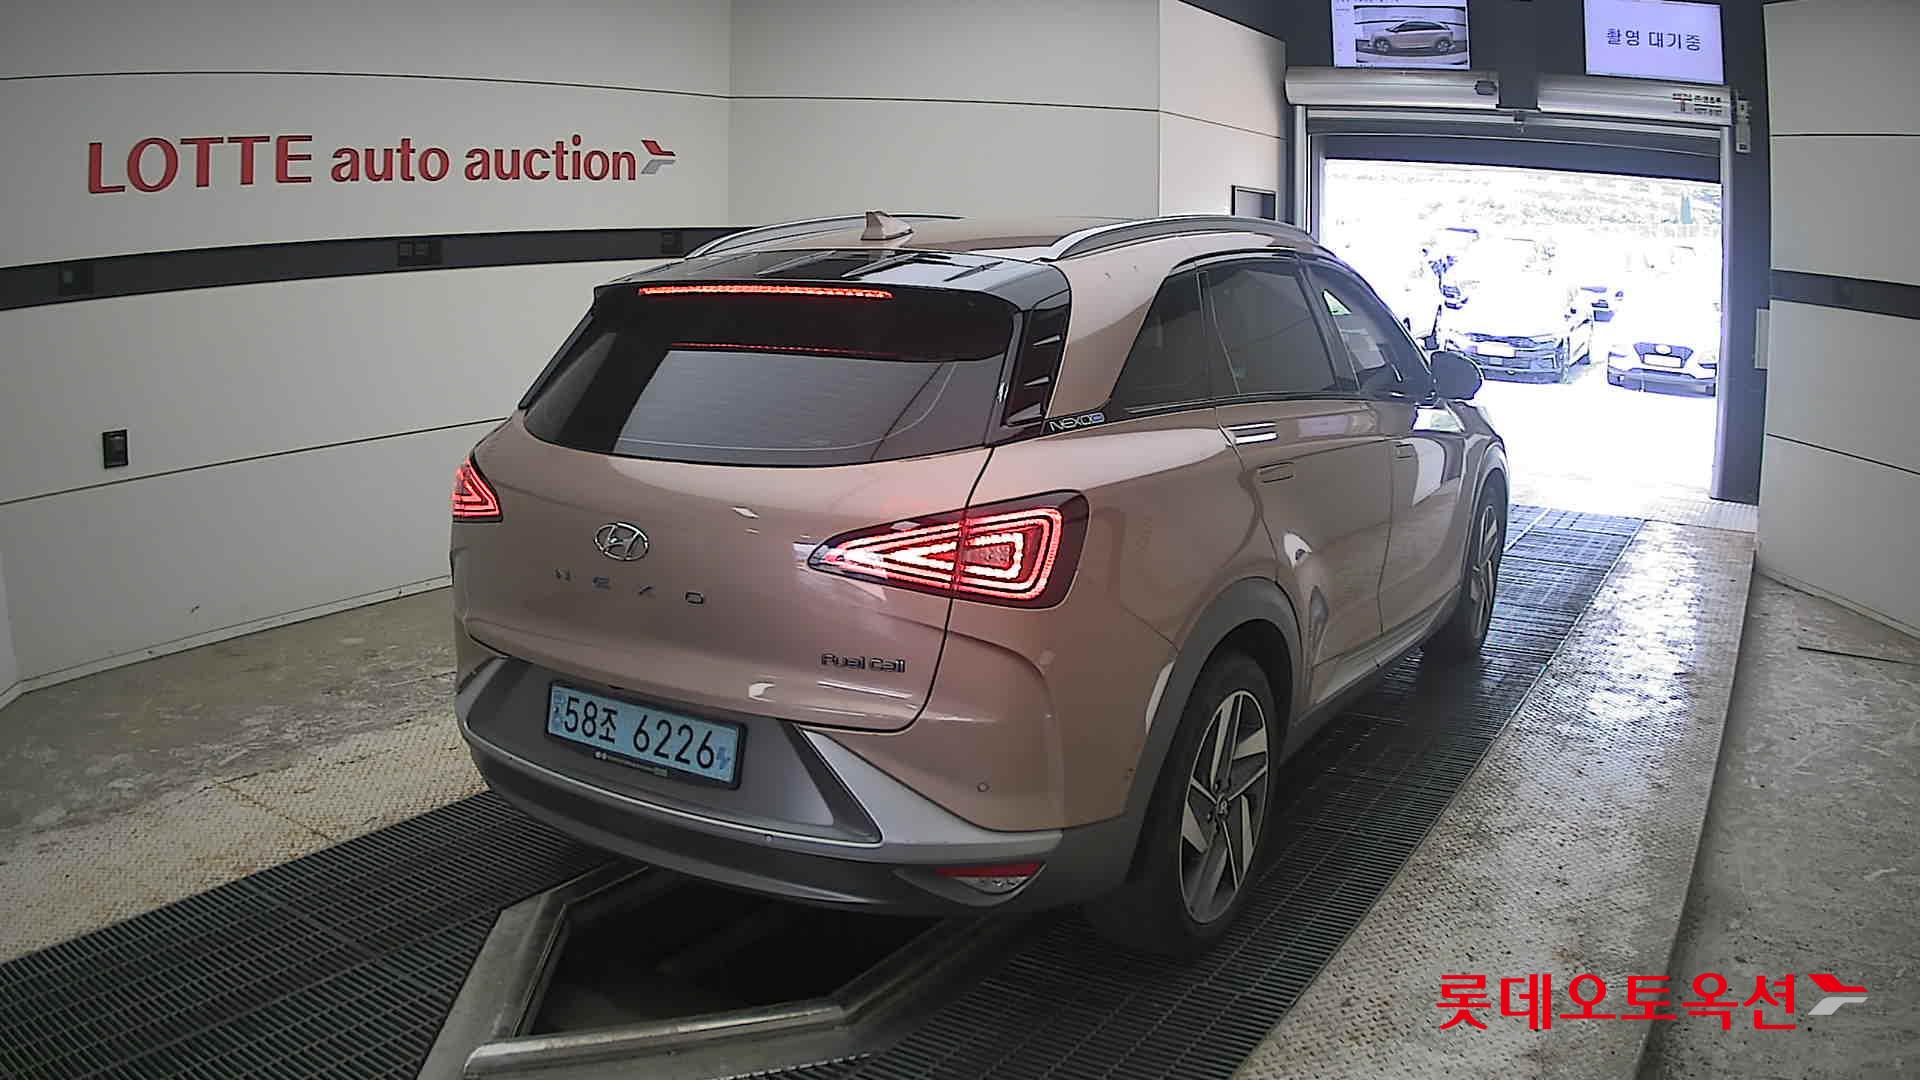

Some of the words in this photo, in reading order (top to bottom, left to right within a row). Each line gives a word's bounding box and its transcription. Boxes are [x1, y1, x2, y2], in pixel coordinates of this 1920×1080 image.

[1607, 28, 1640, 47] 촬영
[1648, 32, 1701, 52] 대기중
[88, 134, 313, 195] LOTTE
[331, 137, 450, 182] auto
[464, 134, 637, 182] auction
[821, 653, 865, 669] Fuel
[871, 657, 906, 673] Cell
[564, 695, 618, 744] 58조
[633, 714, 714, 769] 6226
